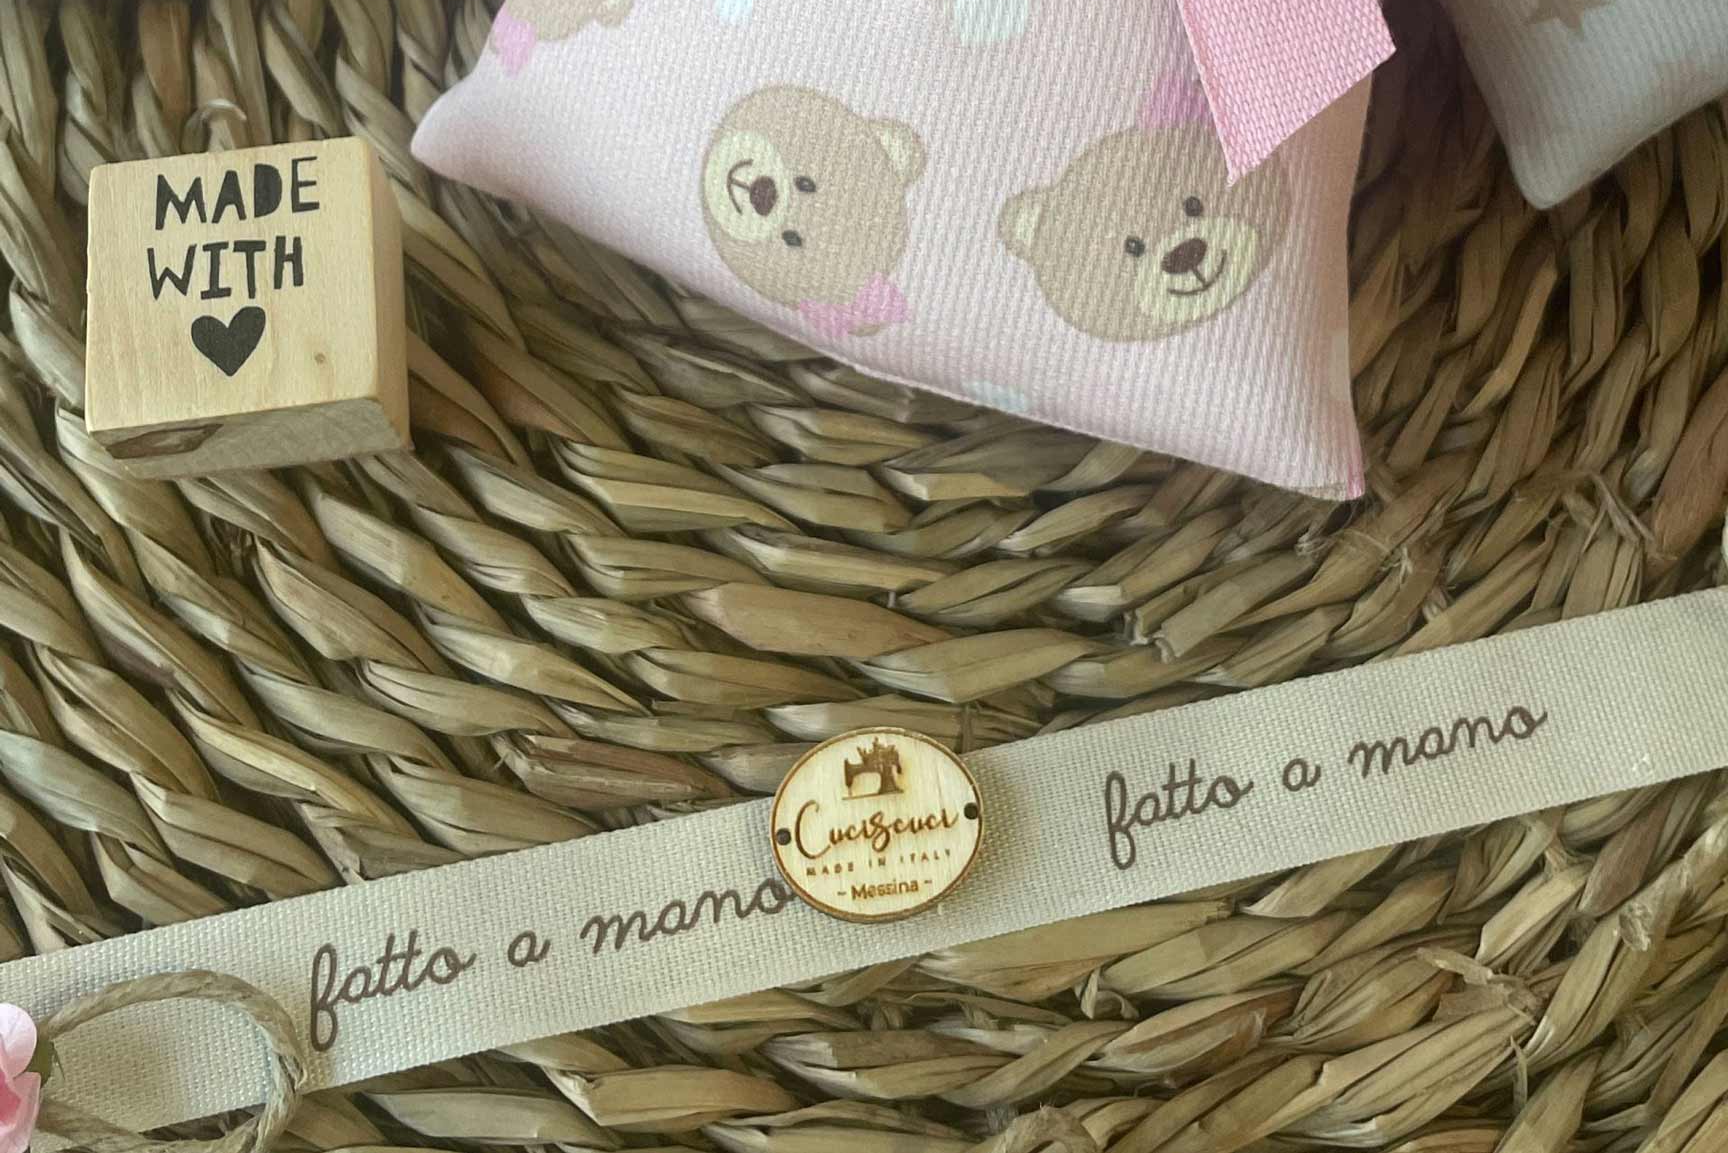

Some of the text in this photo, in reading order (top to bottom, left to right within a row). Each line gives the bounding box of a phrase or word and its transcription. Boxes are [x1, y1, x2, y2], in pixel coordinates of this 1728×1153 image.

[155, 156, 320, 230] MADE
[147, 236, 304, 300] WITH
[1105, 705, 1548, 871] fatto a mano
[806, 848, 952, 877] MADE IN ITALY
[310, 876, 797, 1052] fatto a mano
